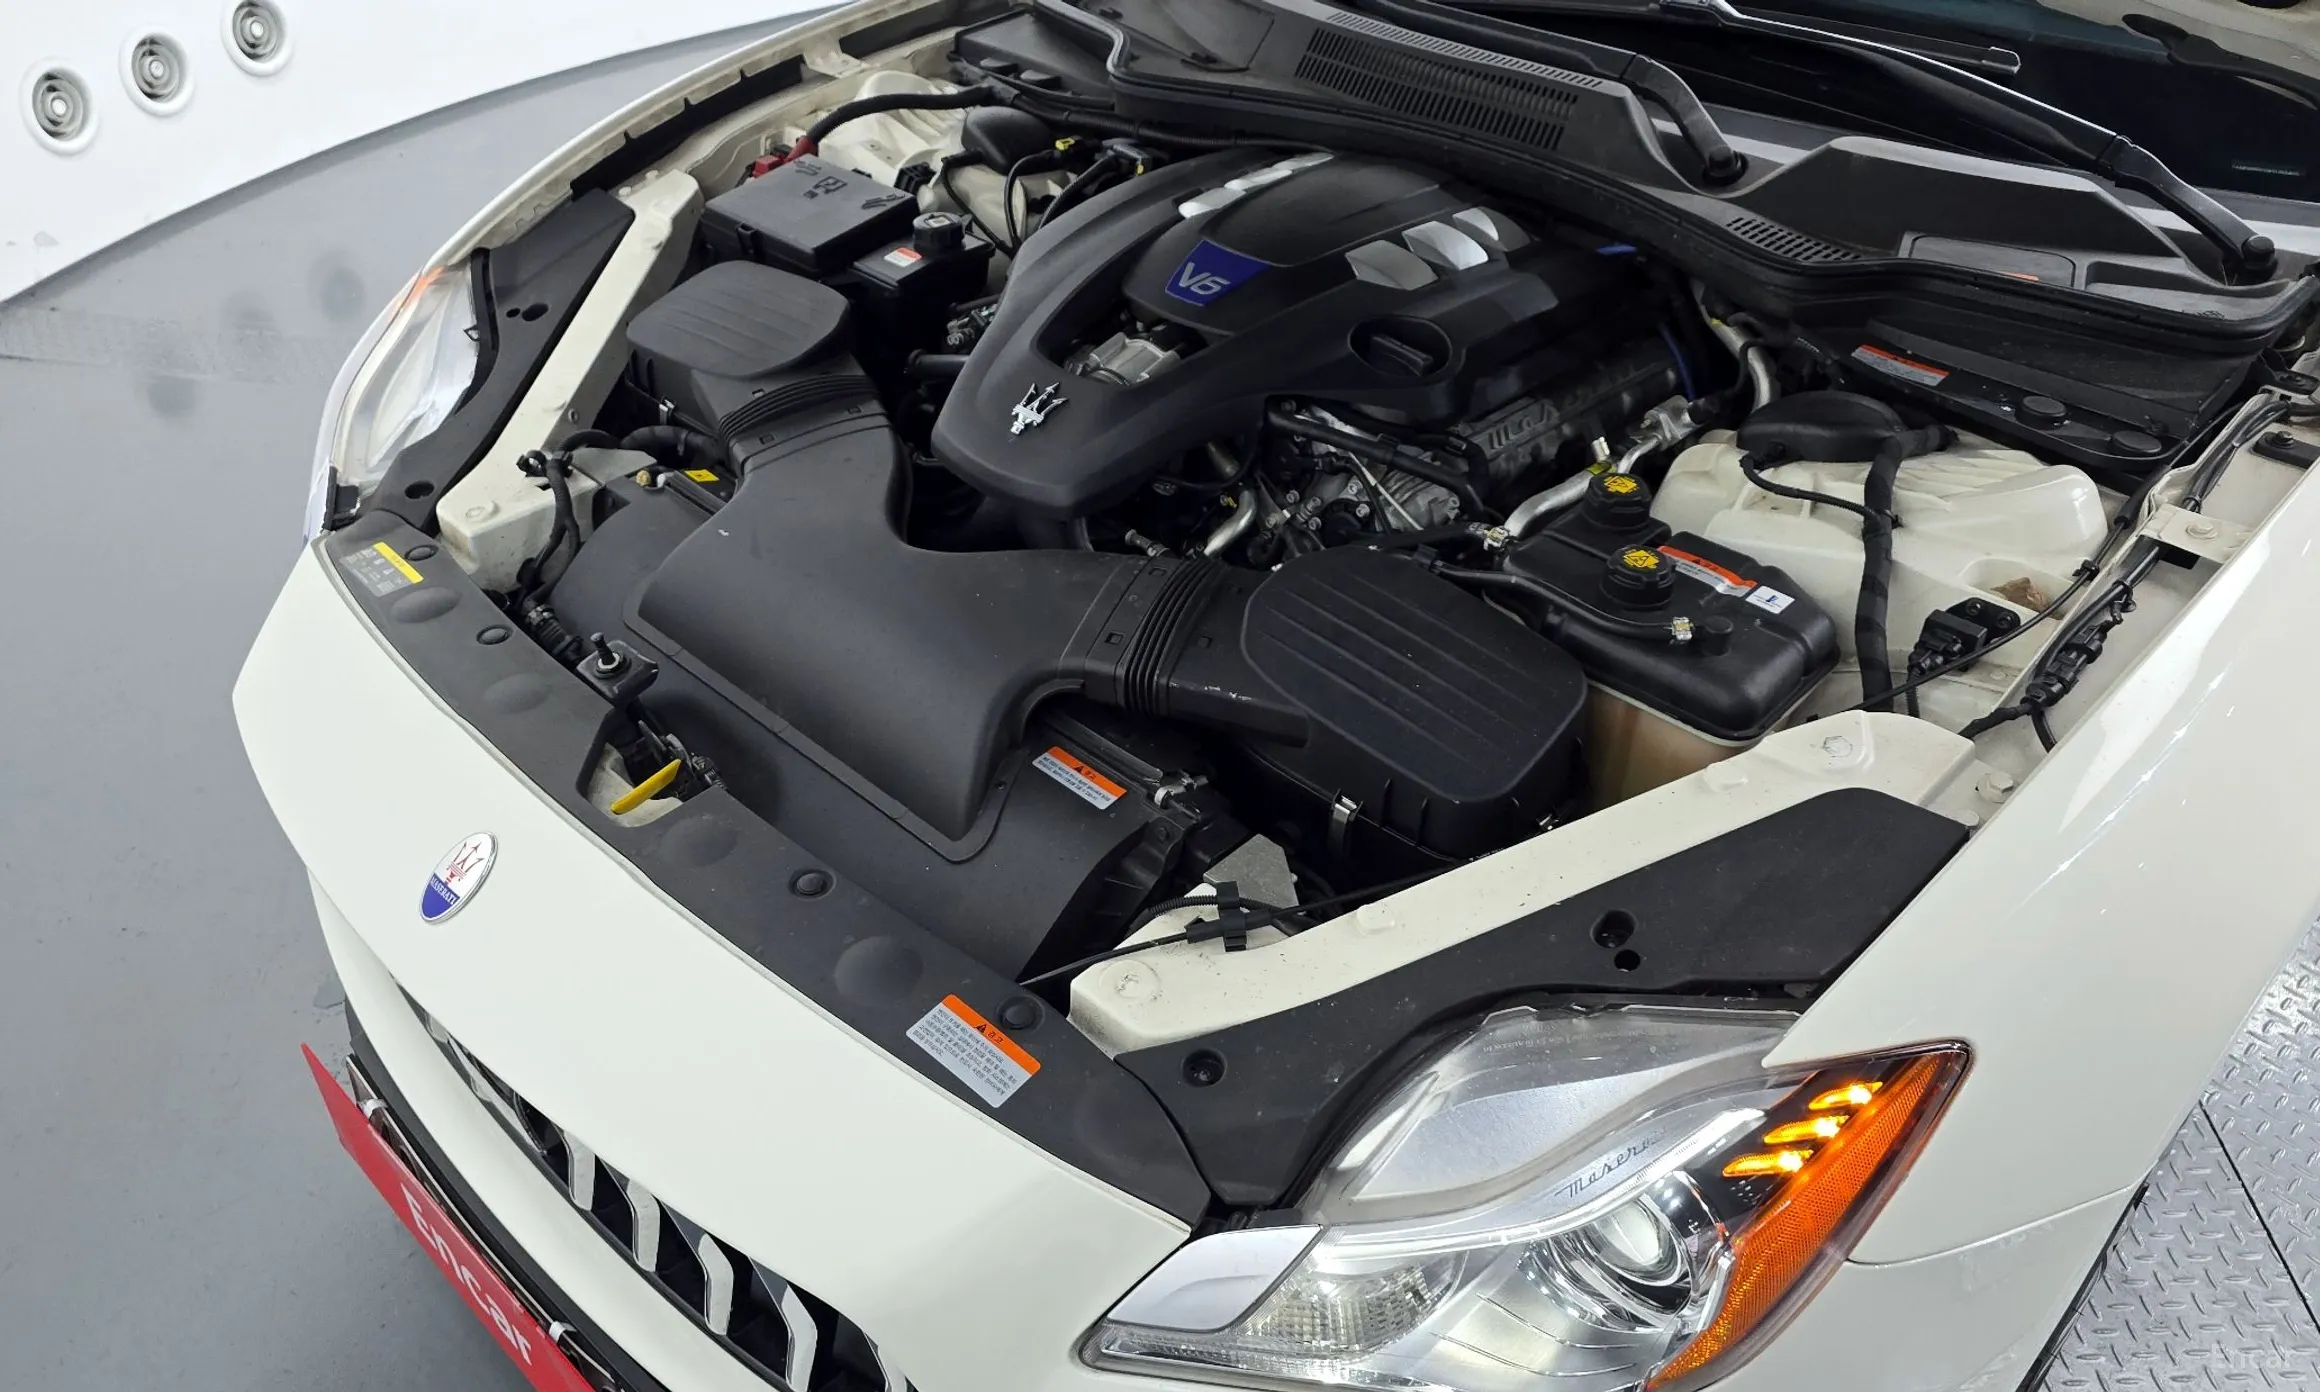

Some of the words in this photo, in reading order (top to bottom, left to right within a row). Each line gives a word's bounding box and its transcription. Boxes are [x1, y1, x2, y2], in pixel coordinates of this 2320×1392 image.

[1178, 261, 1231, 295] V6
[430, 876, 457, 905] MASERATI
[400, 1181, 532, 1367] Encar
